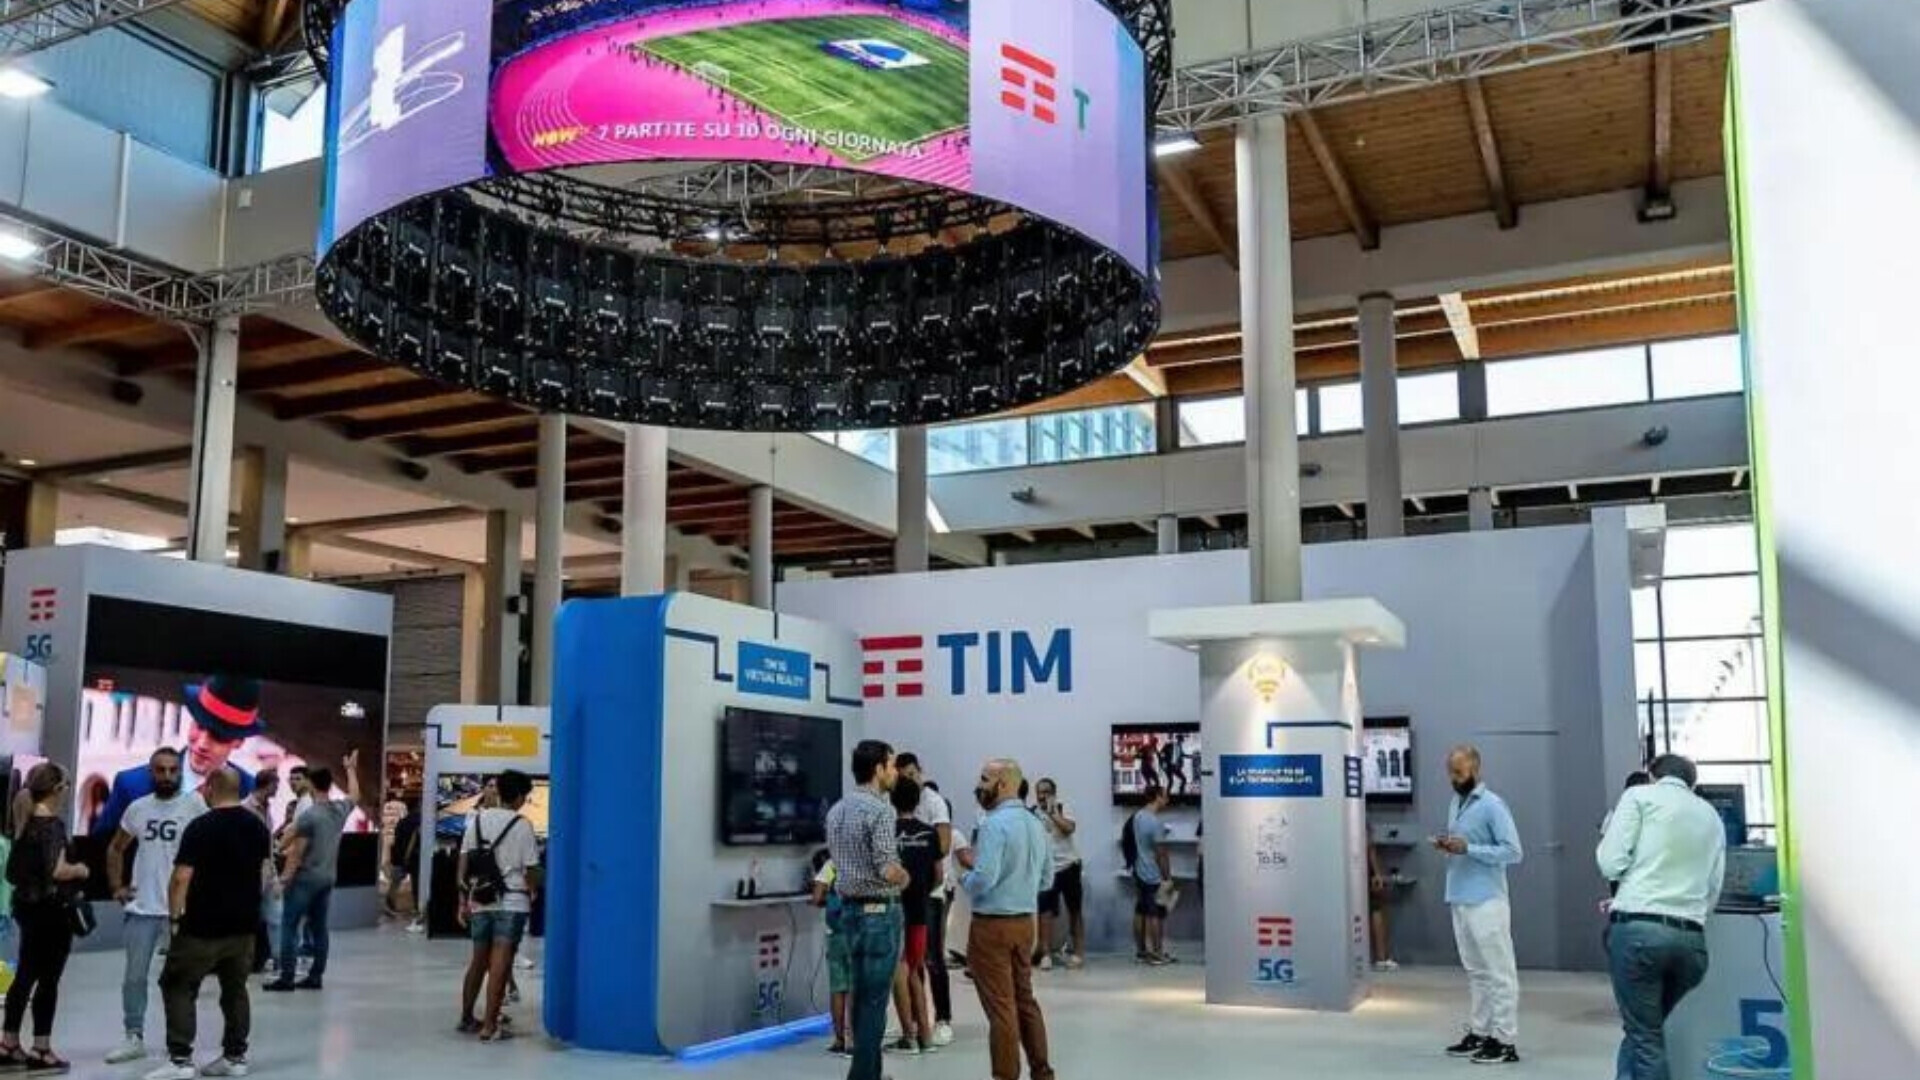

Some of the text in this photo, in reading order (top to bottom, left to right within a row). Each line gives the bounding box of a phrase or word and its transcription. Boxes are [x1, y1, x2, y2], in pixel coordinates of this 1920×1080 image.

[599, 126, 608, 140] 7
[614, 123, 696, 139] PARTITE
[703, 122, 730, 138] SU
[738, 122, 758, 137] 10
[766, 125, 816, 145] OGNI
[824, 130, 922, 159] GIORNATA
[25, 634, 52, 660] 5G
[937, 628, 1072, 695] TIM
[144, 820, 177, 841] 5G
[1258, 958, 1294, 983] 5G
[757, 981, 780, 1011] 5G
